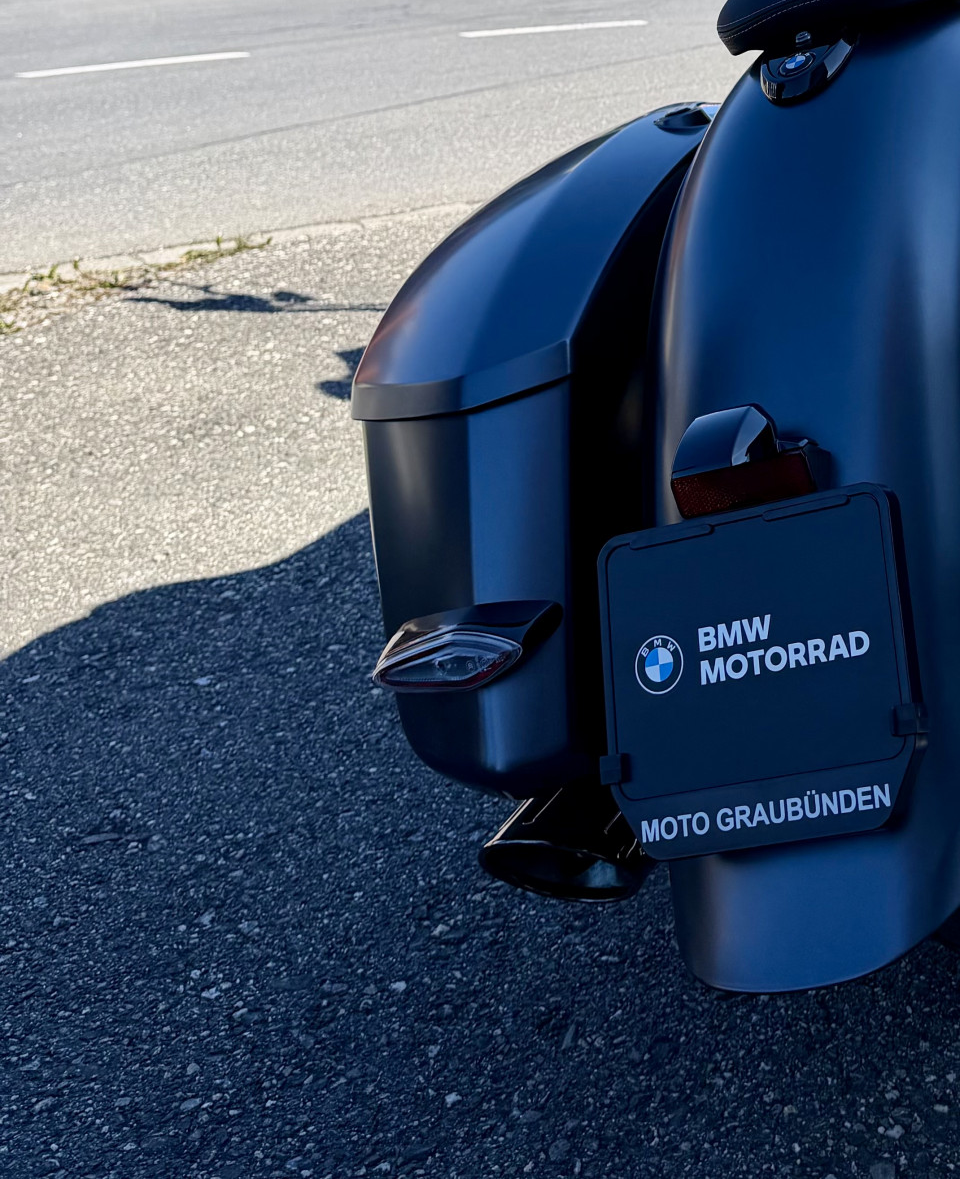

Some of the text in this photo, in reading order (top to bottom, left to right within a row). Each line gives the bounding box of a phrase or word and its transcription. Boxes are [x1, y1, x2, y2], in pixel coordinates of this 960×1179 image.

[640, 637, 677, 658] BMW
[698, 613, 771, 653] BMW
[700, 630, 871, 686] MOTORRAD
[640, 783, 892, 843] MOTO GRAUBÜNDEN
